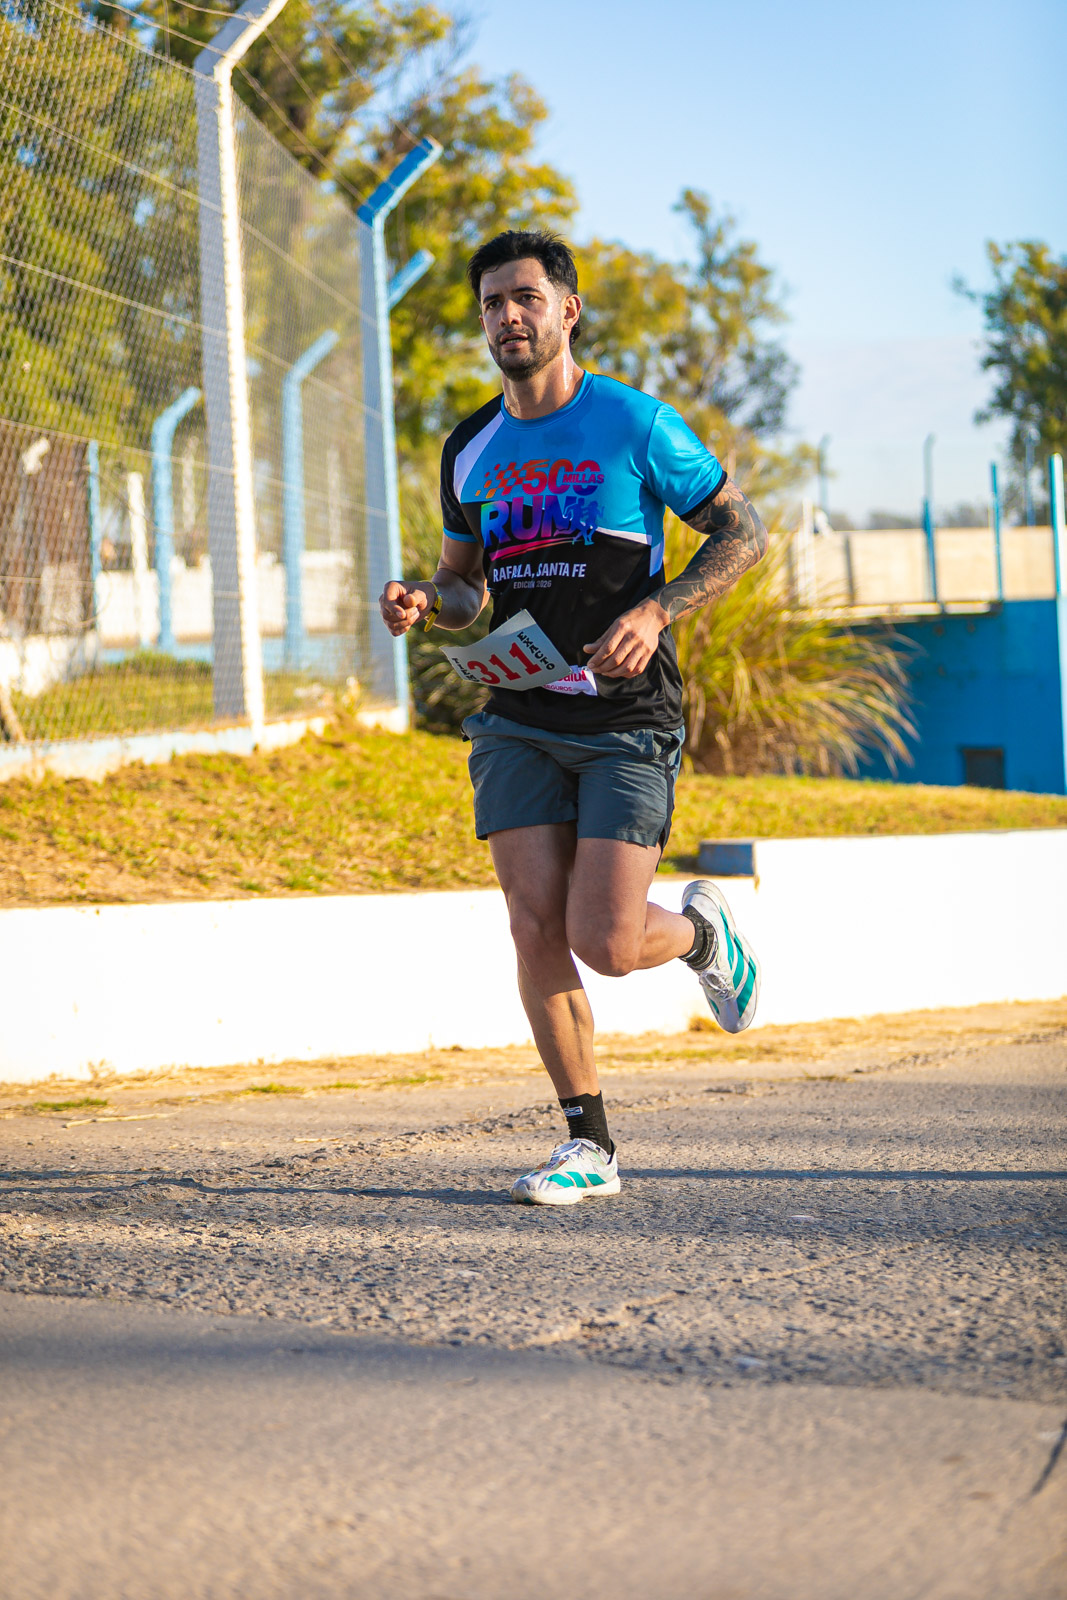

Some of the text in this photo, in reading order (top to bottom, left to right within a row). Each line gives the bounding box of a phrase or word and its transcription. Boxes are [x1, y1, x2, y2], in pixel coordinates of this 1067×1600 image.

[521, 458, 601, 496] 500
[562, 473, 605, 484] MILLAS
[480, 494, 578, 549] RUN
[536, 562, 570, 578] SANTA
[571, 563, 587, 578] FE
[536, 580, 552, 589] 2026
[467, 642, 542, 685] 311
[516, 631, 556, 671] EXACTO
